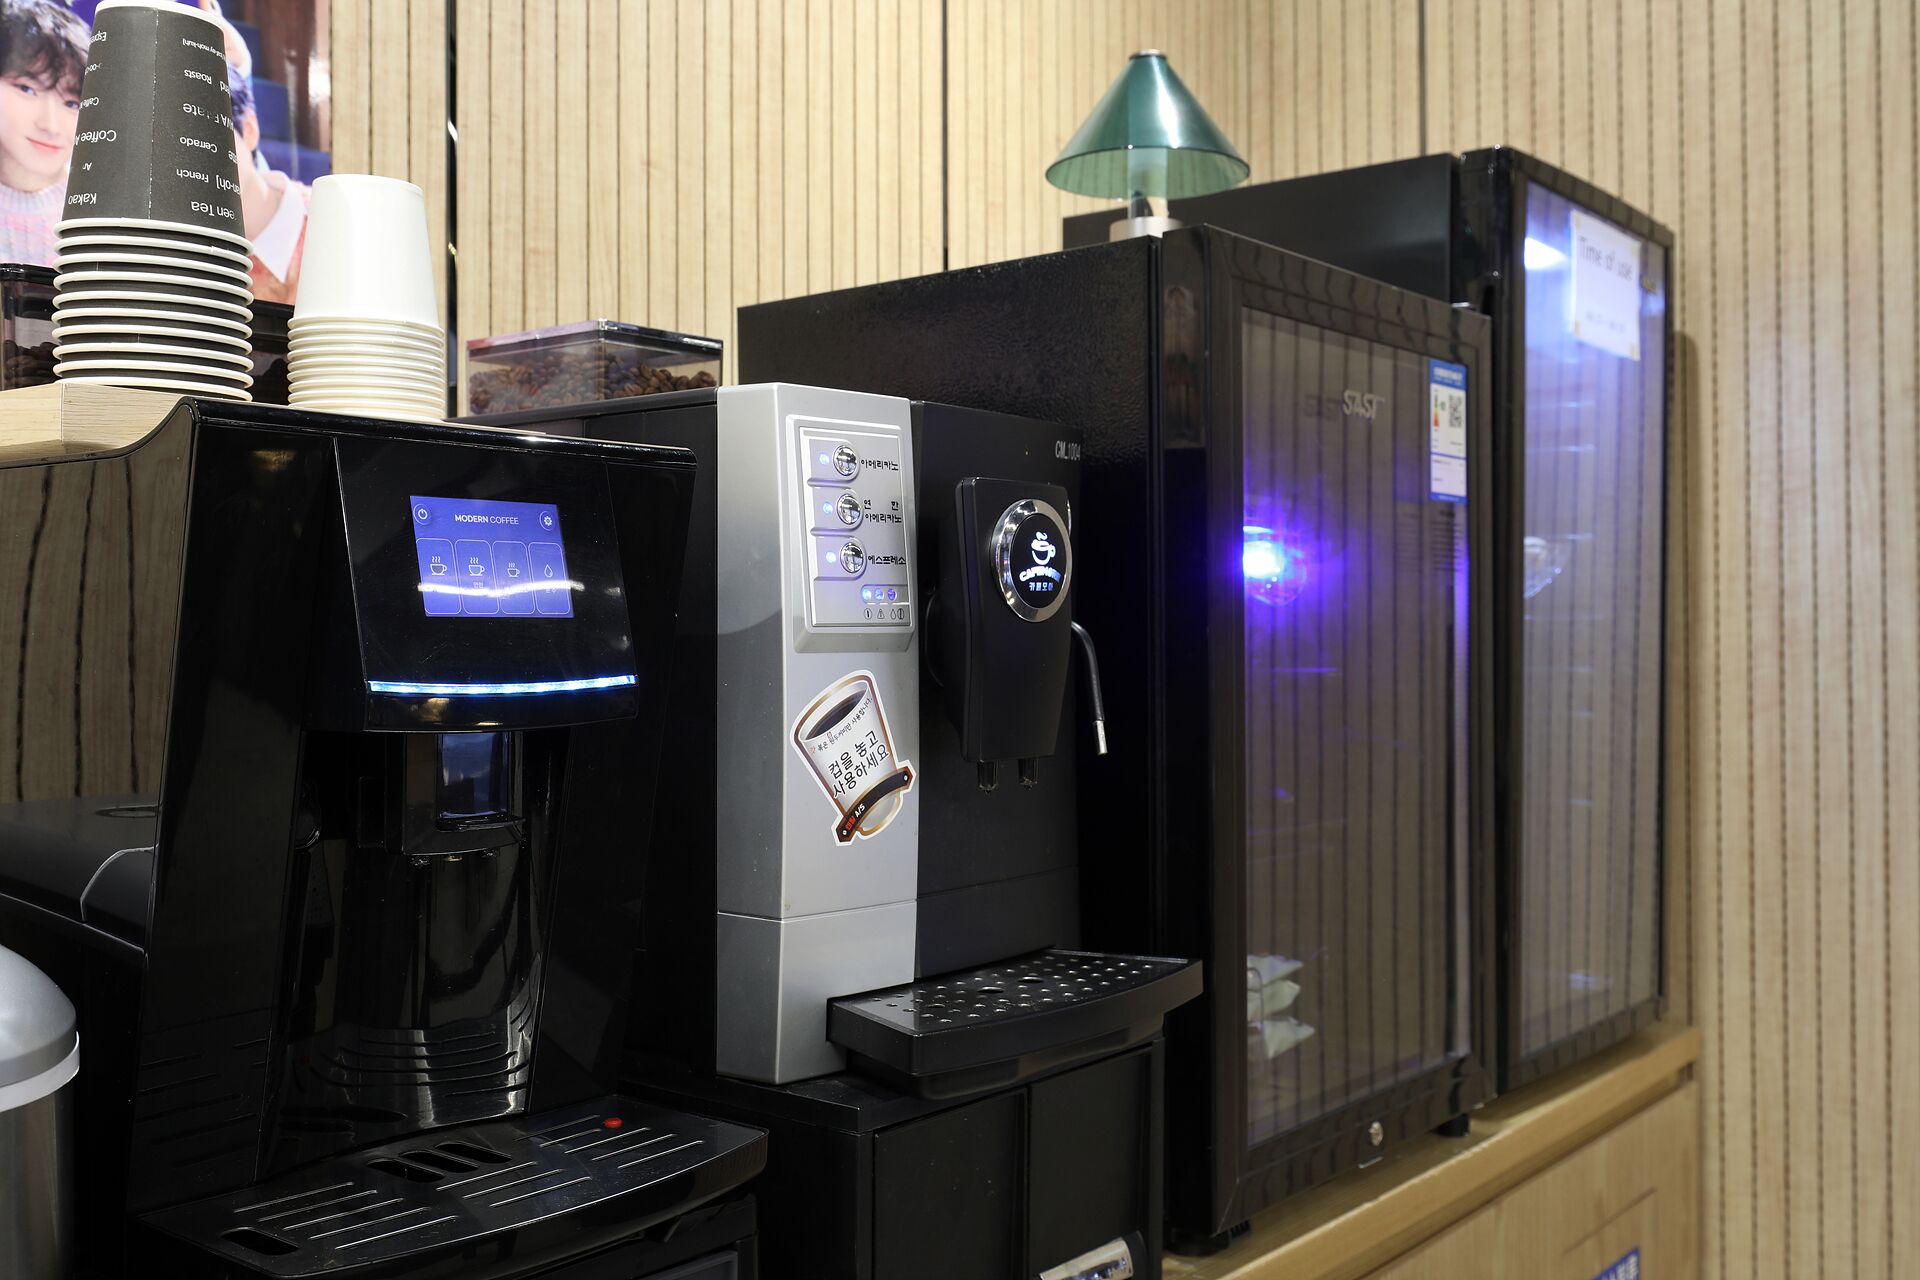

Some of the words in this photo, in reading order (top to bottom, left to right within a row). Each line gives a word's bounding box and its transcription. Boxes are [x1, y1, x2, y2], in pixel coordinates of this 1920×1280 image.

[184, 69, 212, 85] Roasts
[81, 129, 117, 143] Coffee
[180, 136, 217, 153] Cerrado
[176, 168, 209, 183] French
[68, 193, 97, 206] Kakao
[190, 201, 215, 217] Tea
[1579, 235, 1602, 267] Time
[1343, 389, 1385, 420] SAST
[860, 459, 899, 471] 아메리카노
[454, 514, 489, 524] MODERN
[489, 516, 520, 525] COFFEE
[864, 513, 902, 524] 아메리카노
[868, 555, 907, 565] 에스프레소
[828, 751, 854, 779] 컵을
[854, 730, 879, 757] 놓고
[833, 744, 889, 798] 사용하세요
[854, 803, 866, 818] A/S
